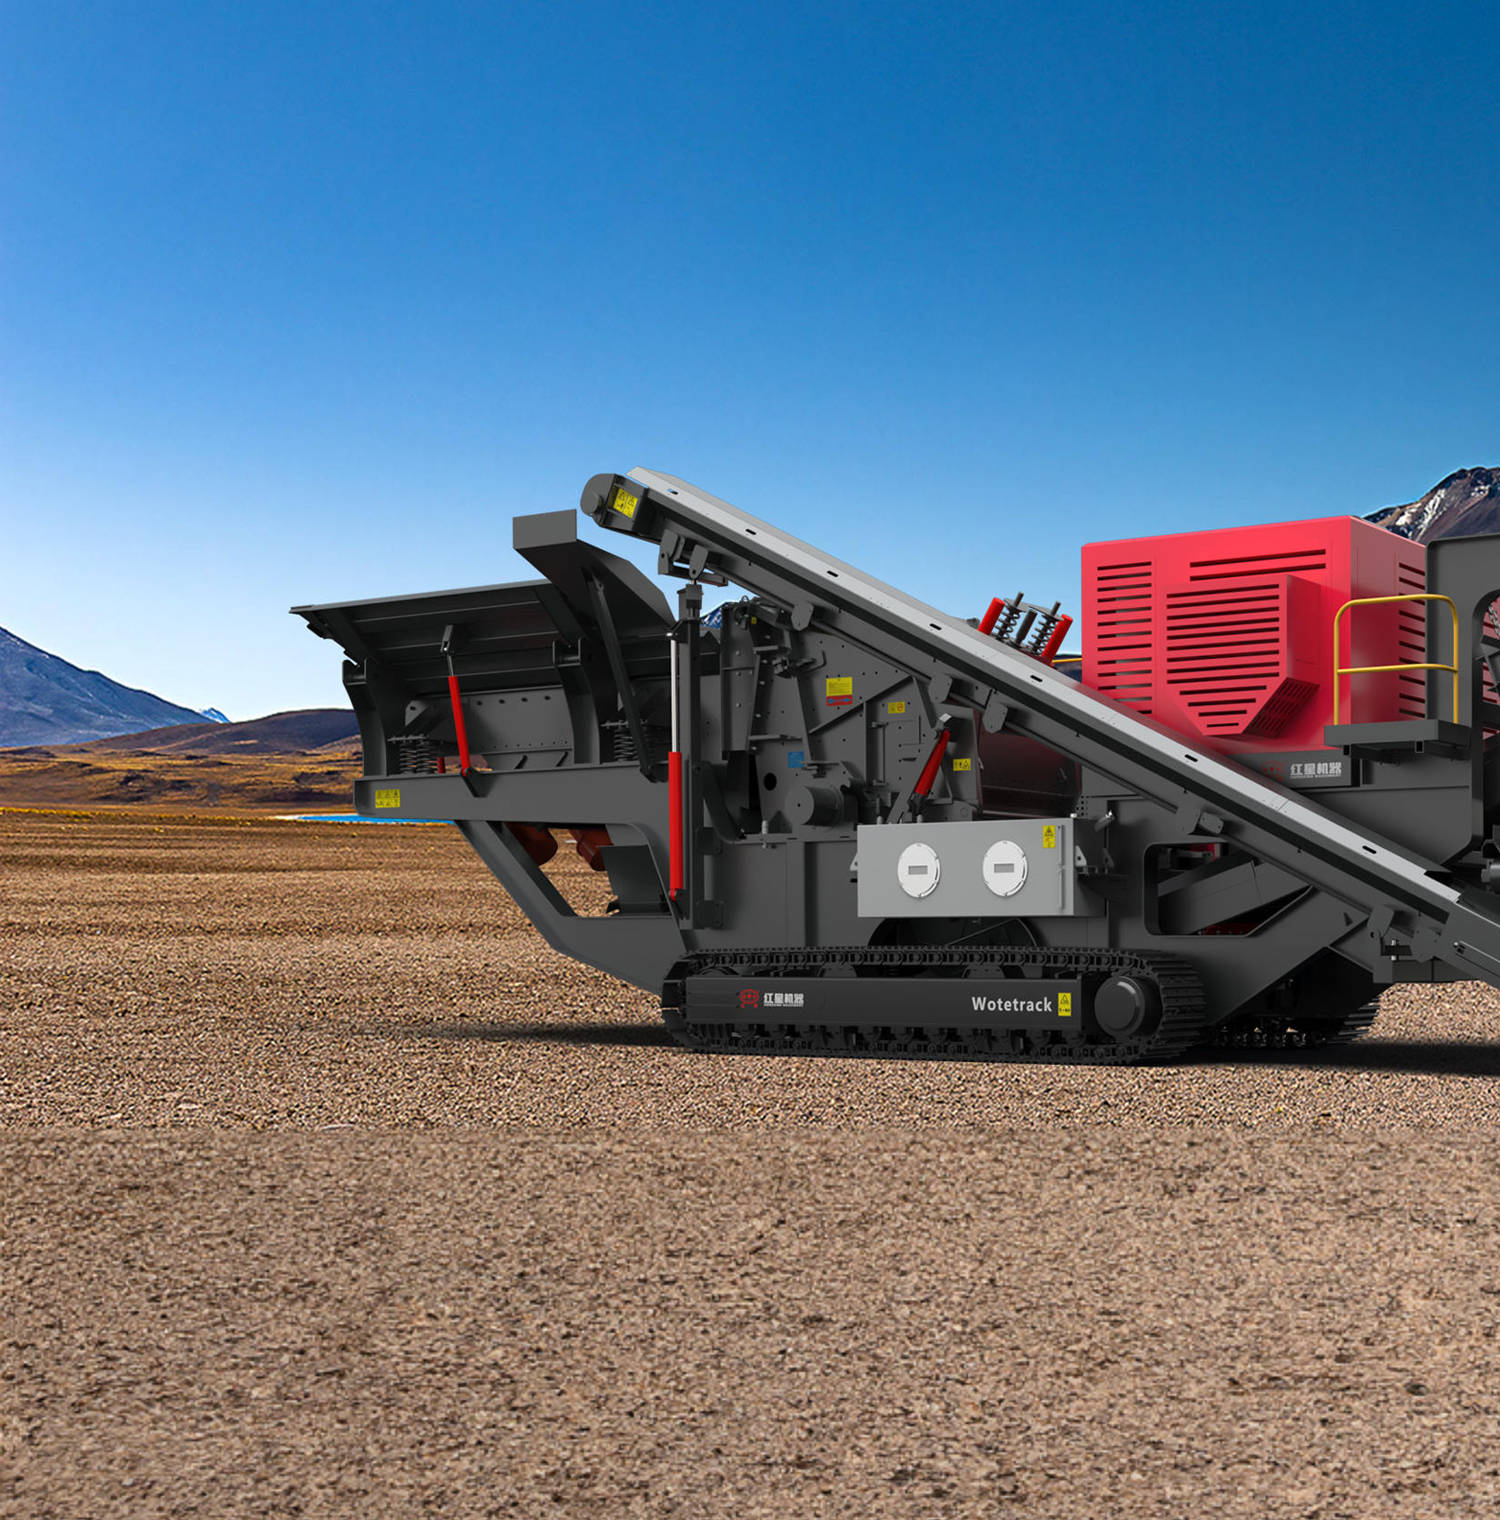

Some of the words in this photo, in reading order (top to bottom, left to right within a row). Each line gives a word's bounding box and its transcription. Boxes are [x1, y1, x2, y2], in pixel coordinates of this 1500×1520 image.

[1290, 762, 1342, 776] 红星机器
[763, 993, 804, 1004] 红星机器
[971, 996, 1052, 1012] Wotetrack
